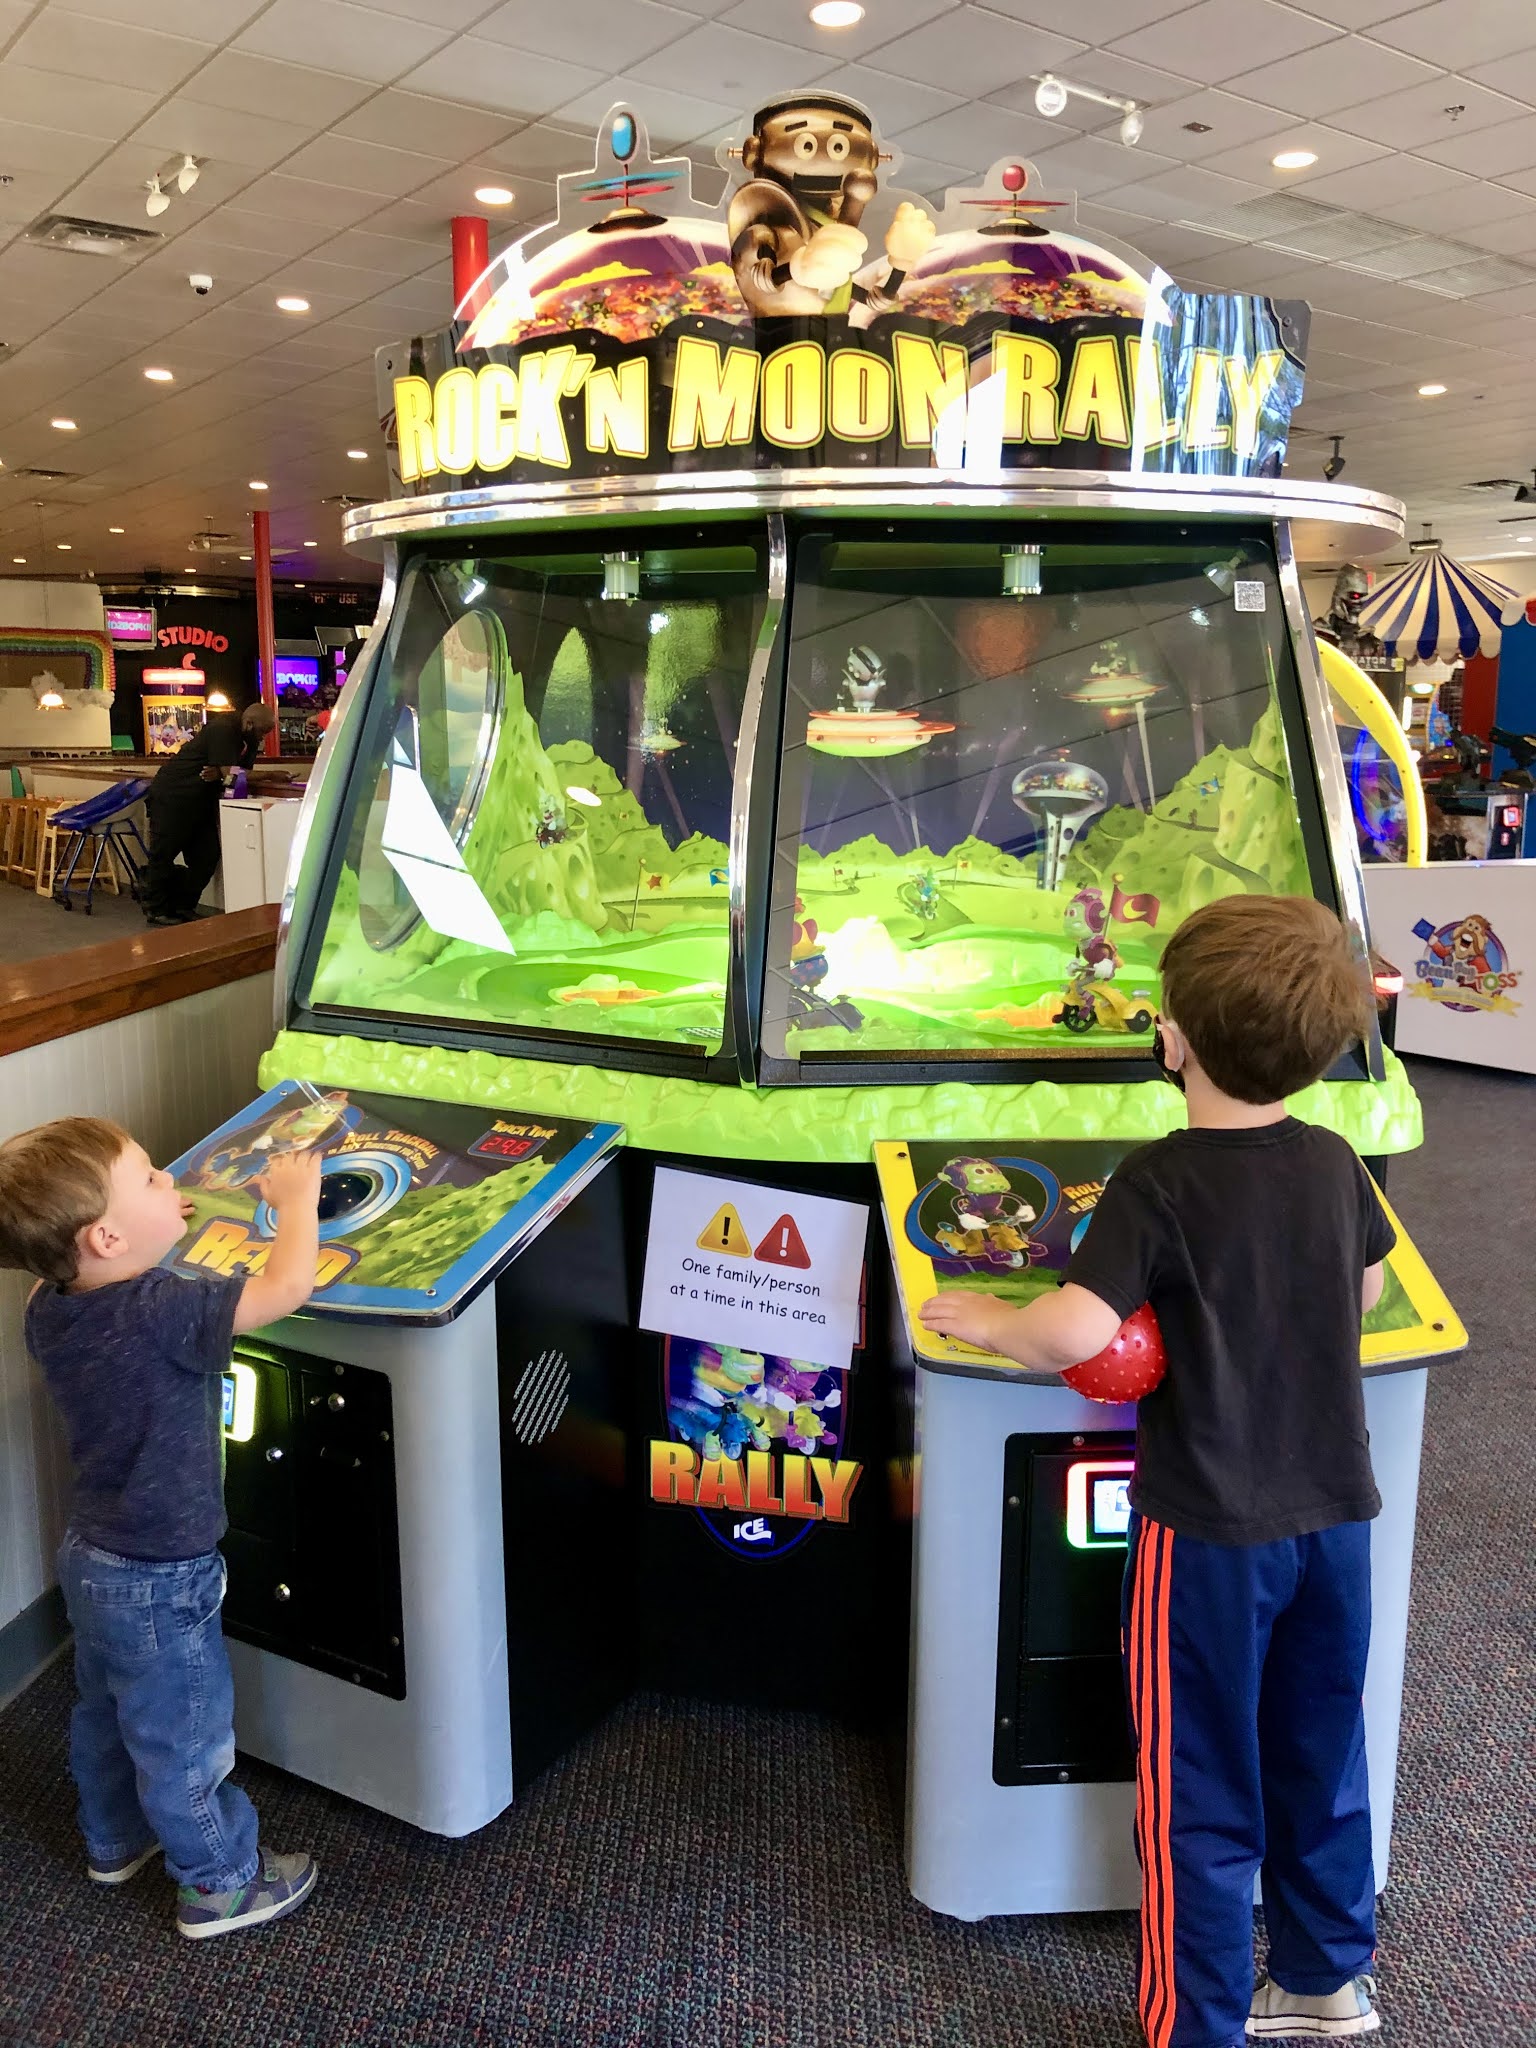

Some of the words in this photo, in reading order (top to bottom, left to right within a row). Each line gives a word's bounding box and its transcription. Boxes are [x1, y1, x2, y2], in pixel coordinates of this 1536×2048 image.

[667, 331, 969, 453] MOON
[991, 331, 1285, 459] RALLY
[157, 626, 229, 653] STUDIO
[182, 652, 196, 669] C
[491, 1119, 531, 1136] TRACK
[528, 1124, 558, 1139] TIME
[344, 1132, 380, 1144] ROLL
[384, 1130, 440, 1159] TRACKBALL
[1062, 1181, 1105, 1200] ROLL
[682, 1257, 711, 1275] One
[716, 1264, 821, 1297] family/person
[670, 1283, 686, 1296] at
[690, 1289, 698, 1299] a
[704, 1289, 736, 1307] time
[741, 1296, 754, 1311] in
[759, 1300, 788, 1318] this
[792, 1311, 826, 1325] area
[650, 1440, 862, 1522] RALLY
[734, 1518, 772, 1541] ICE
